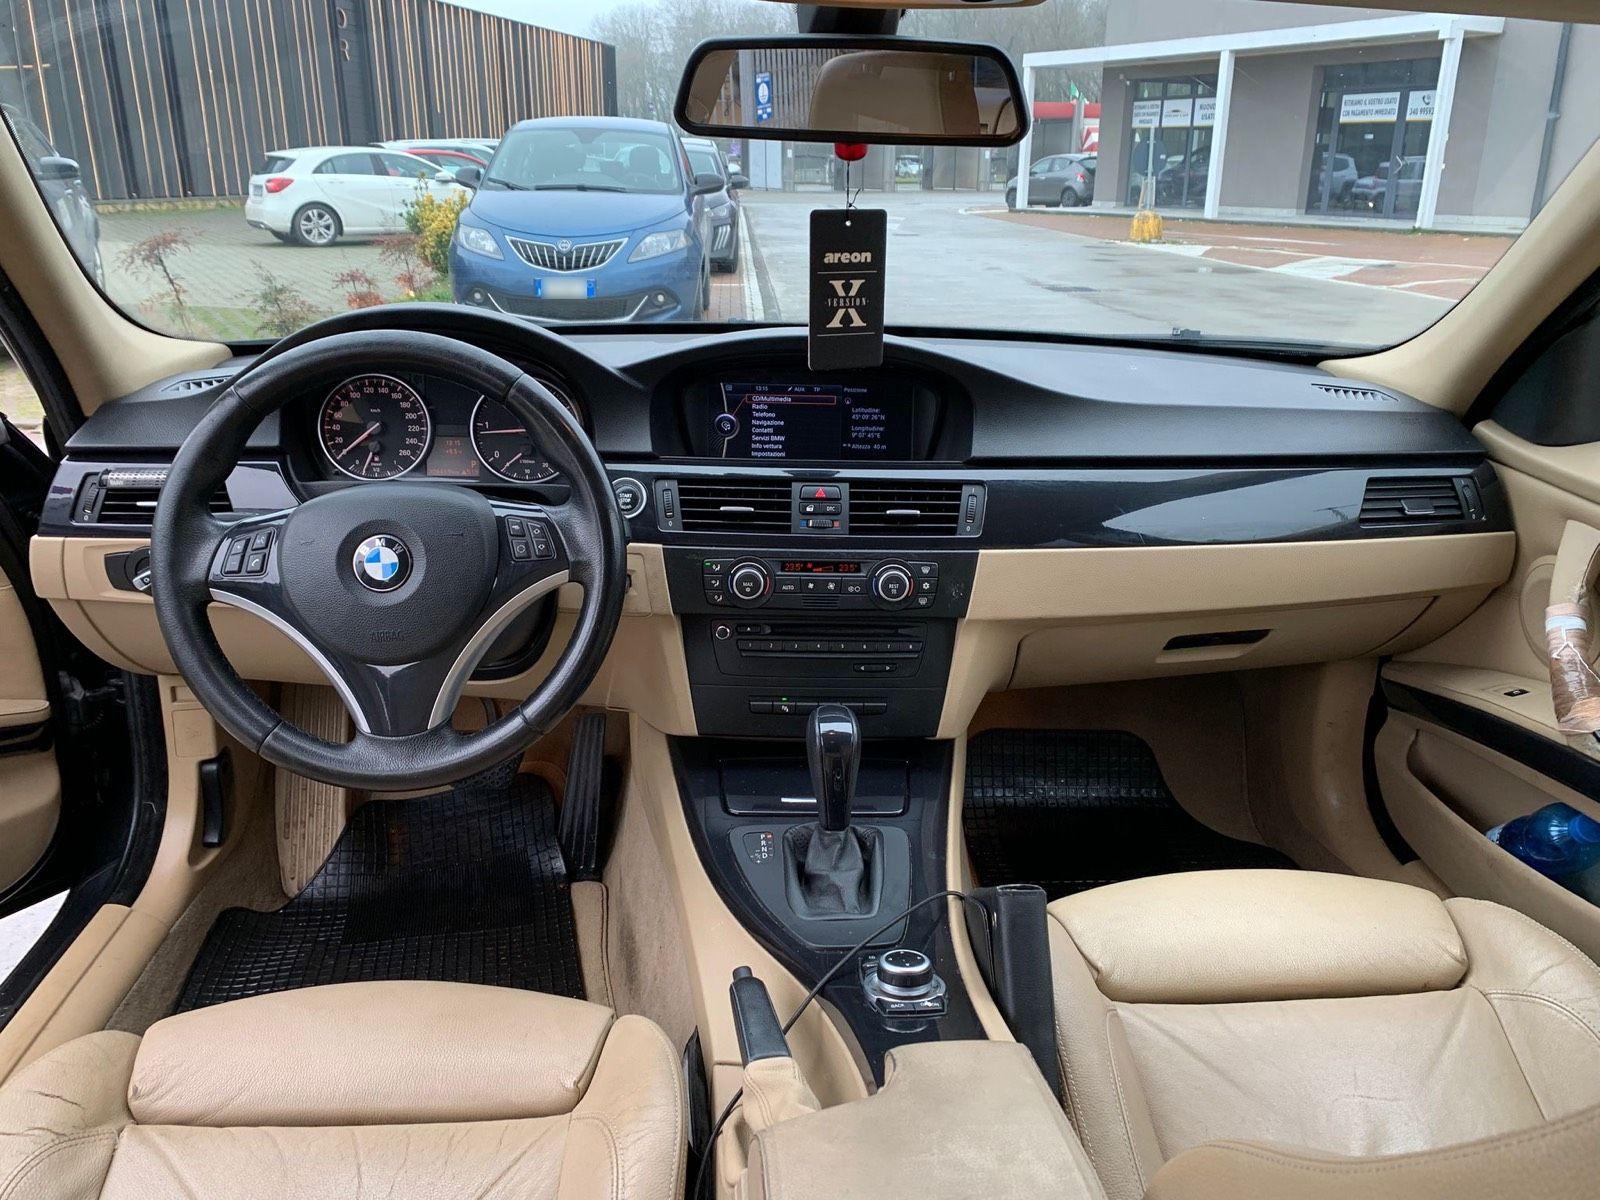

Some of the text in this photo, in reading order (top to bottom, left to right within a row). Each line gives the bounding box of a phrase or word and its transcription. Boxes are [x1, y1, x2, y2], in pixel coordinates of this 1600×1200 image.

[824, 252, 872, 264] areon
[828, 297, 867, 307] VERSION
[360, 538, 404, 556] BMW
